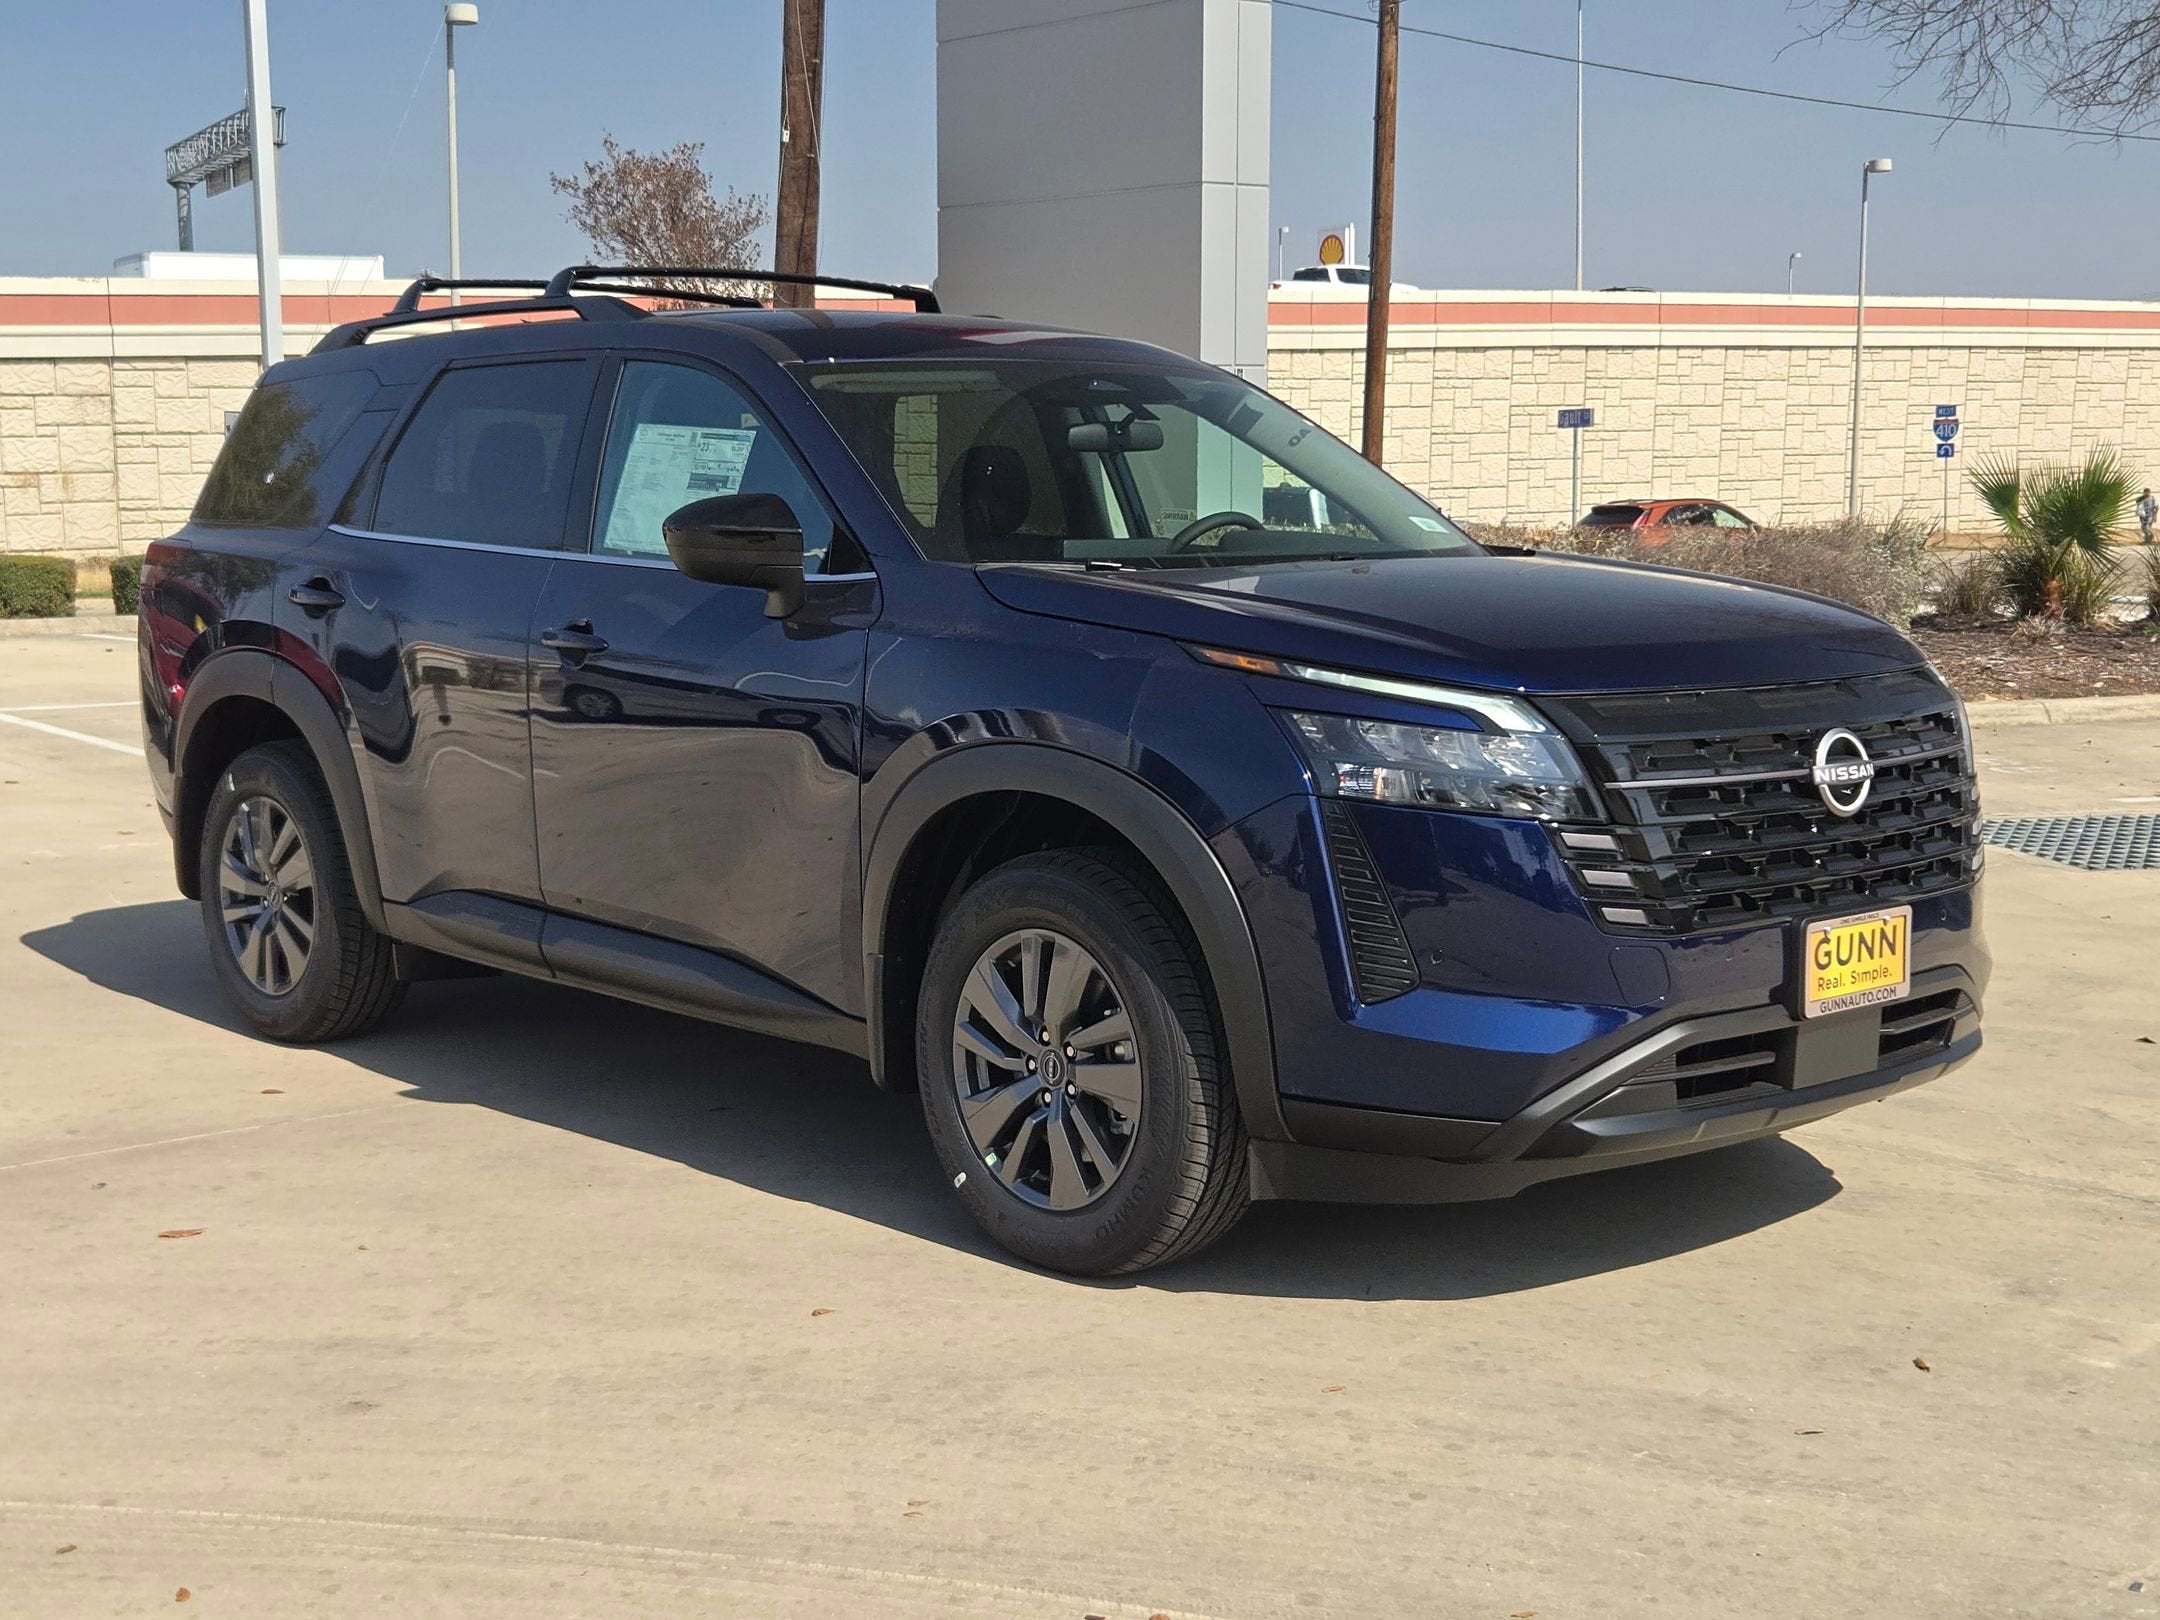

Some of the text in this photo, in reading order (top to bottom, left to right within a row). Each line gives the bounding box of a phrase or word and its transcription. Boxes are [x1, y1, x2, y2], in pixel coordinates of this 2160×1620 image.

[1938, 407, 1954, 416] WEST
[1936, 424, 1957, 438] 410
[1815, 762, 1875, 783] NISSAN
[1814, 924, 1898, 971] GUNN
[1817, 964, 1893, 992] Real. Simple.
[1819, 986, 1897, 1013] GUNNAUTO.COM
